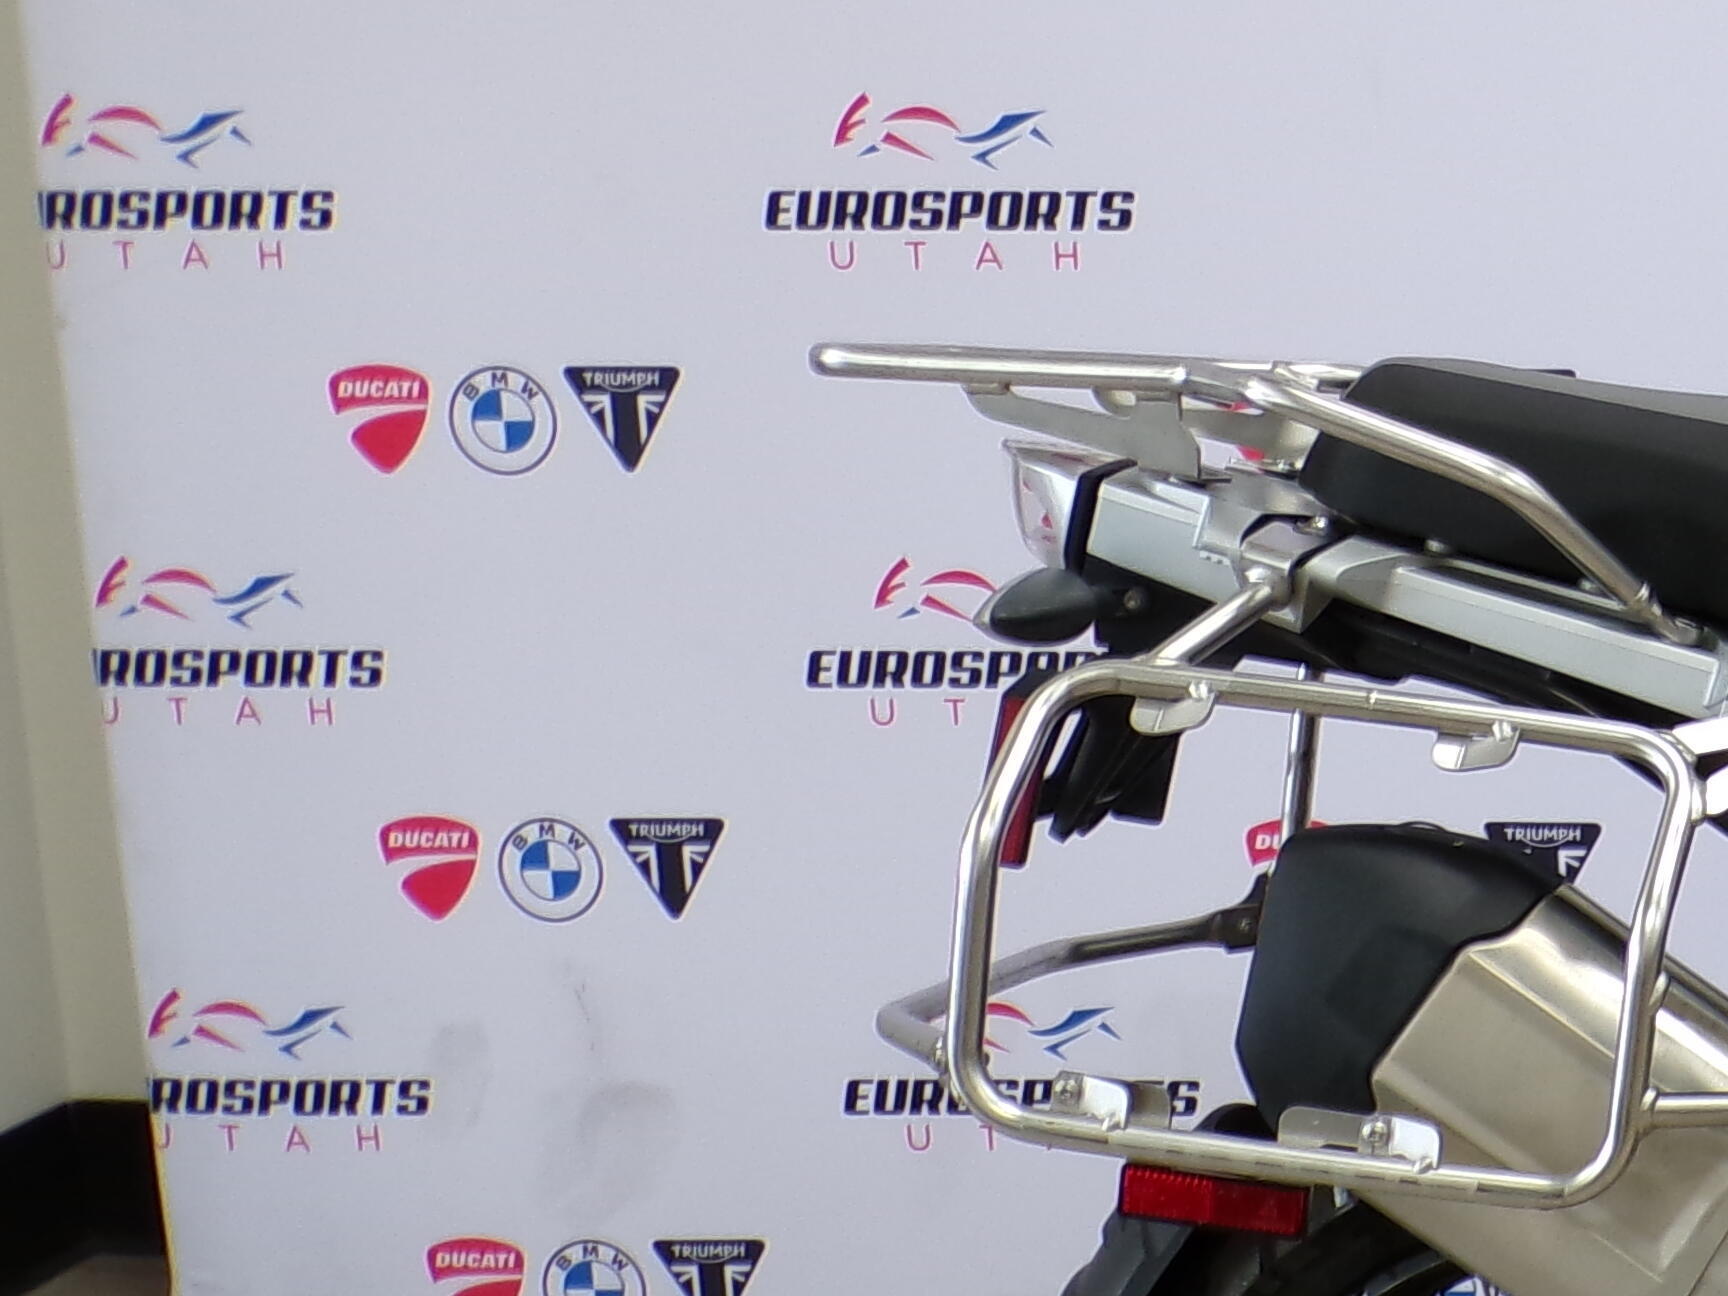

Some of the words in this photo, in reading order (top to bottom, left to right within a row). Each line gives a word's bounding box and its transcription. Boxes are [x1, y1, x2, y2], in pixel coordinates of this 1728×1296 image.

[39, 191, 334, 231] ROSPORTS
[766, 191, 1135, 231] EUROSPORTS
[828, 240, 1081, 272] UTAH
[338, 379, 420, 398] DUCATI
[462, 372, 539, 400] BMW
[582, 373, 660, 387] TRIUMPH
[93, 649, 384, 688] ROSPORTS
[388, 831, 469, 849] DUCATI
[512, 824, 587, 852] BMW
[628, 824, 704, 837] TRIUMPH
[1504, 828, 1581, 842] TRIUMPH
[150, 1078, 432, 1116] ROSPORTS
[435, 1251, 515, 1268] DUCATI
[556, 1245, 629, 1271] BMW
[671, 1245, 746, 1258] TRIUMPH
